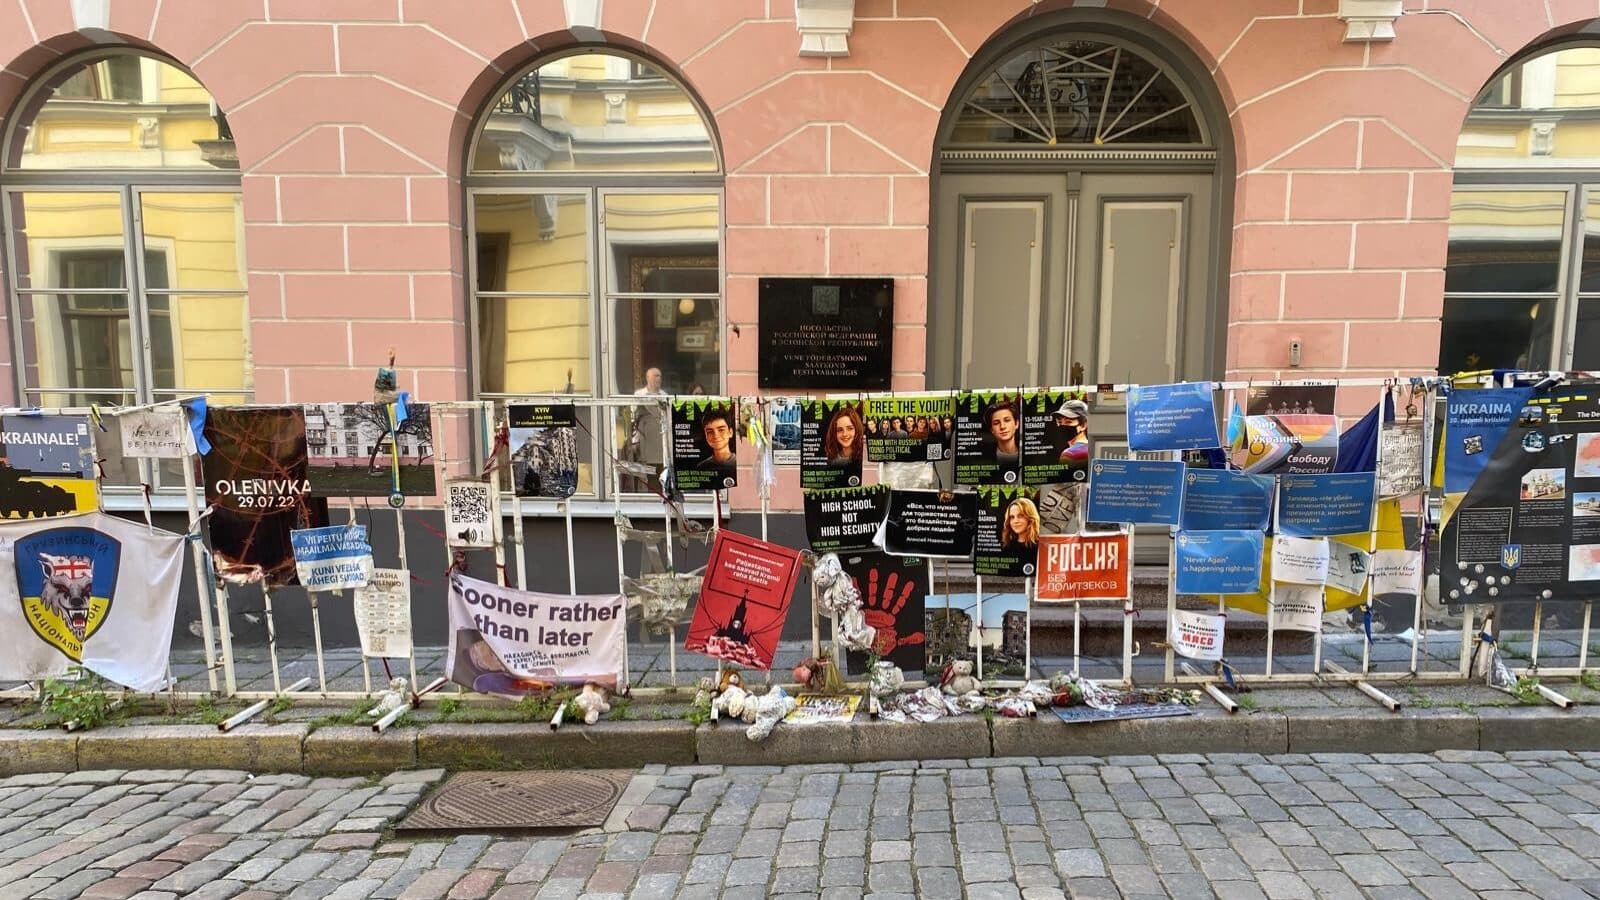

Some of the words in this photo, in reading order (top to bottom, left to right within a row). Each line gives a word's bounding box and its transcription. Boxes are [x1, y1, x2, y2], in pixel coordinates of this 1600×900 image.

[800, 324, 852, 332] ПОСОЛЬСТВО
[827, 339, 879, 347] РЕСПУБЛИКЕ
[784, 354, 803, 362] VENE
[805, 361, 846, 369] SAATKOND
[793, 368, 814, 376] EESTI
[534, 406, 550, 414] KYIV
[870, 400, 894, 414] FREE
[897, 400, 916, 414] THE
[919, 399, 950, 413] YOUTH
[1450, 403, 1512, 415] UKRAINA
[0, 431, 79, 446] KRAINALE!
[1287, 454, 1331, 466] Свободу
[1288, 466, 1329, 475] России!
[215, 479, 312, 495] OLENIVKA
[238, 495, 296, 508] 29.07.22
[821, 501, 841, 513] HIGH
[842, 498, 876, 511] SCHOOL,
[841, 512, 858, 523] NOT
[821, 526, 841, 537] HIGH
[842, 521, 881, 536] SECURITY
[1047, 541, 1119, 573] РОССИЯ
[1183, 556, 1206, 564] "Never
[1206, 556, 1229, 566] Again"
[311, 566, 334, 576] KUNI
[1189, 565, 1225, 574] happening
[1225, 565, 1241, 574] right
[375, 572, 399, 580] SASHA
[732, 570, 748, 579] raha
[748, 574, 768, 586] Eestis
[1047, 573, 1067, 583] БЕЗ
[1047, 580, 1118, 593] ПОЛИТЗЕКОВ
[549, 602, 622, 622] rather
[474, 613, 529, 643] than
[538, 625, 593, 647] later
[1182, 632, 1214, 646] МЯСО
